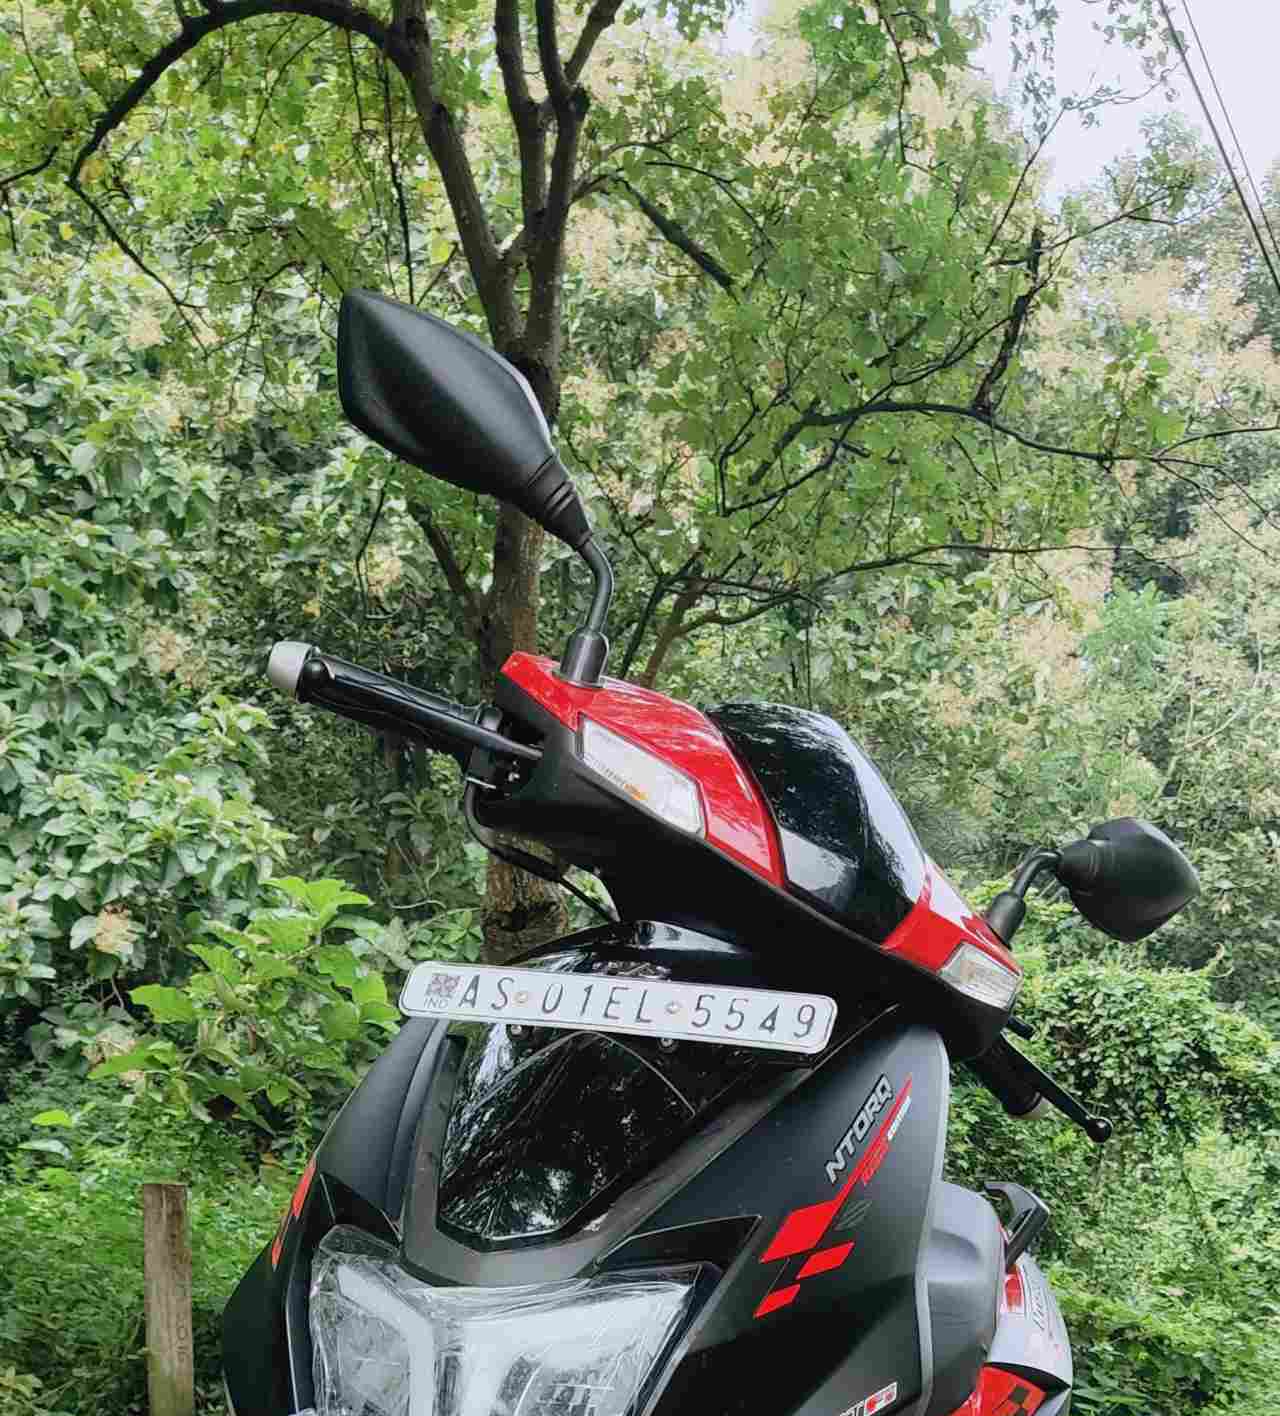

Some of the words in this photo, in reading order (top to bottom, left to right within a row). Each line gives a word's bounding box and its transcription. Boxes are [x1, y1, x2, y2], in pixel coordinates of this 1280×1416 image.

[457, 975, 515, 1013] AS
[541, 983, 653, 1024] 01EL
[691, 994, 817, 1039] 5549
[825, 1074, 894, 1184] NTORQ
